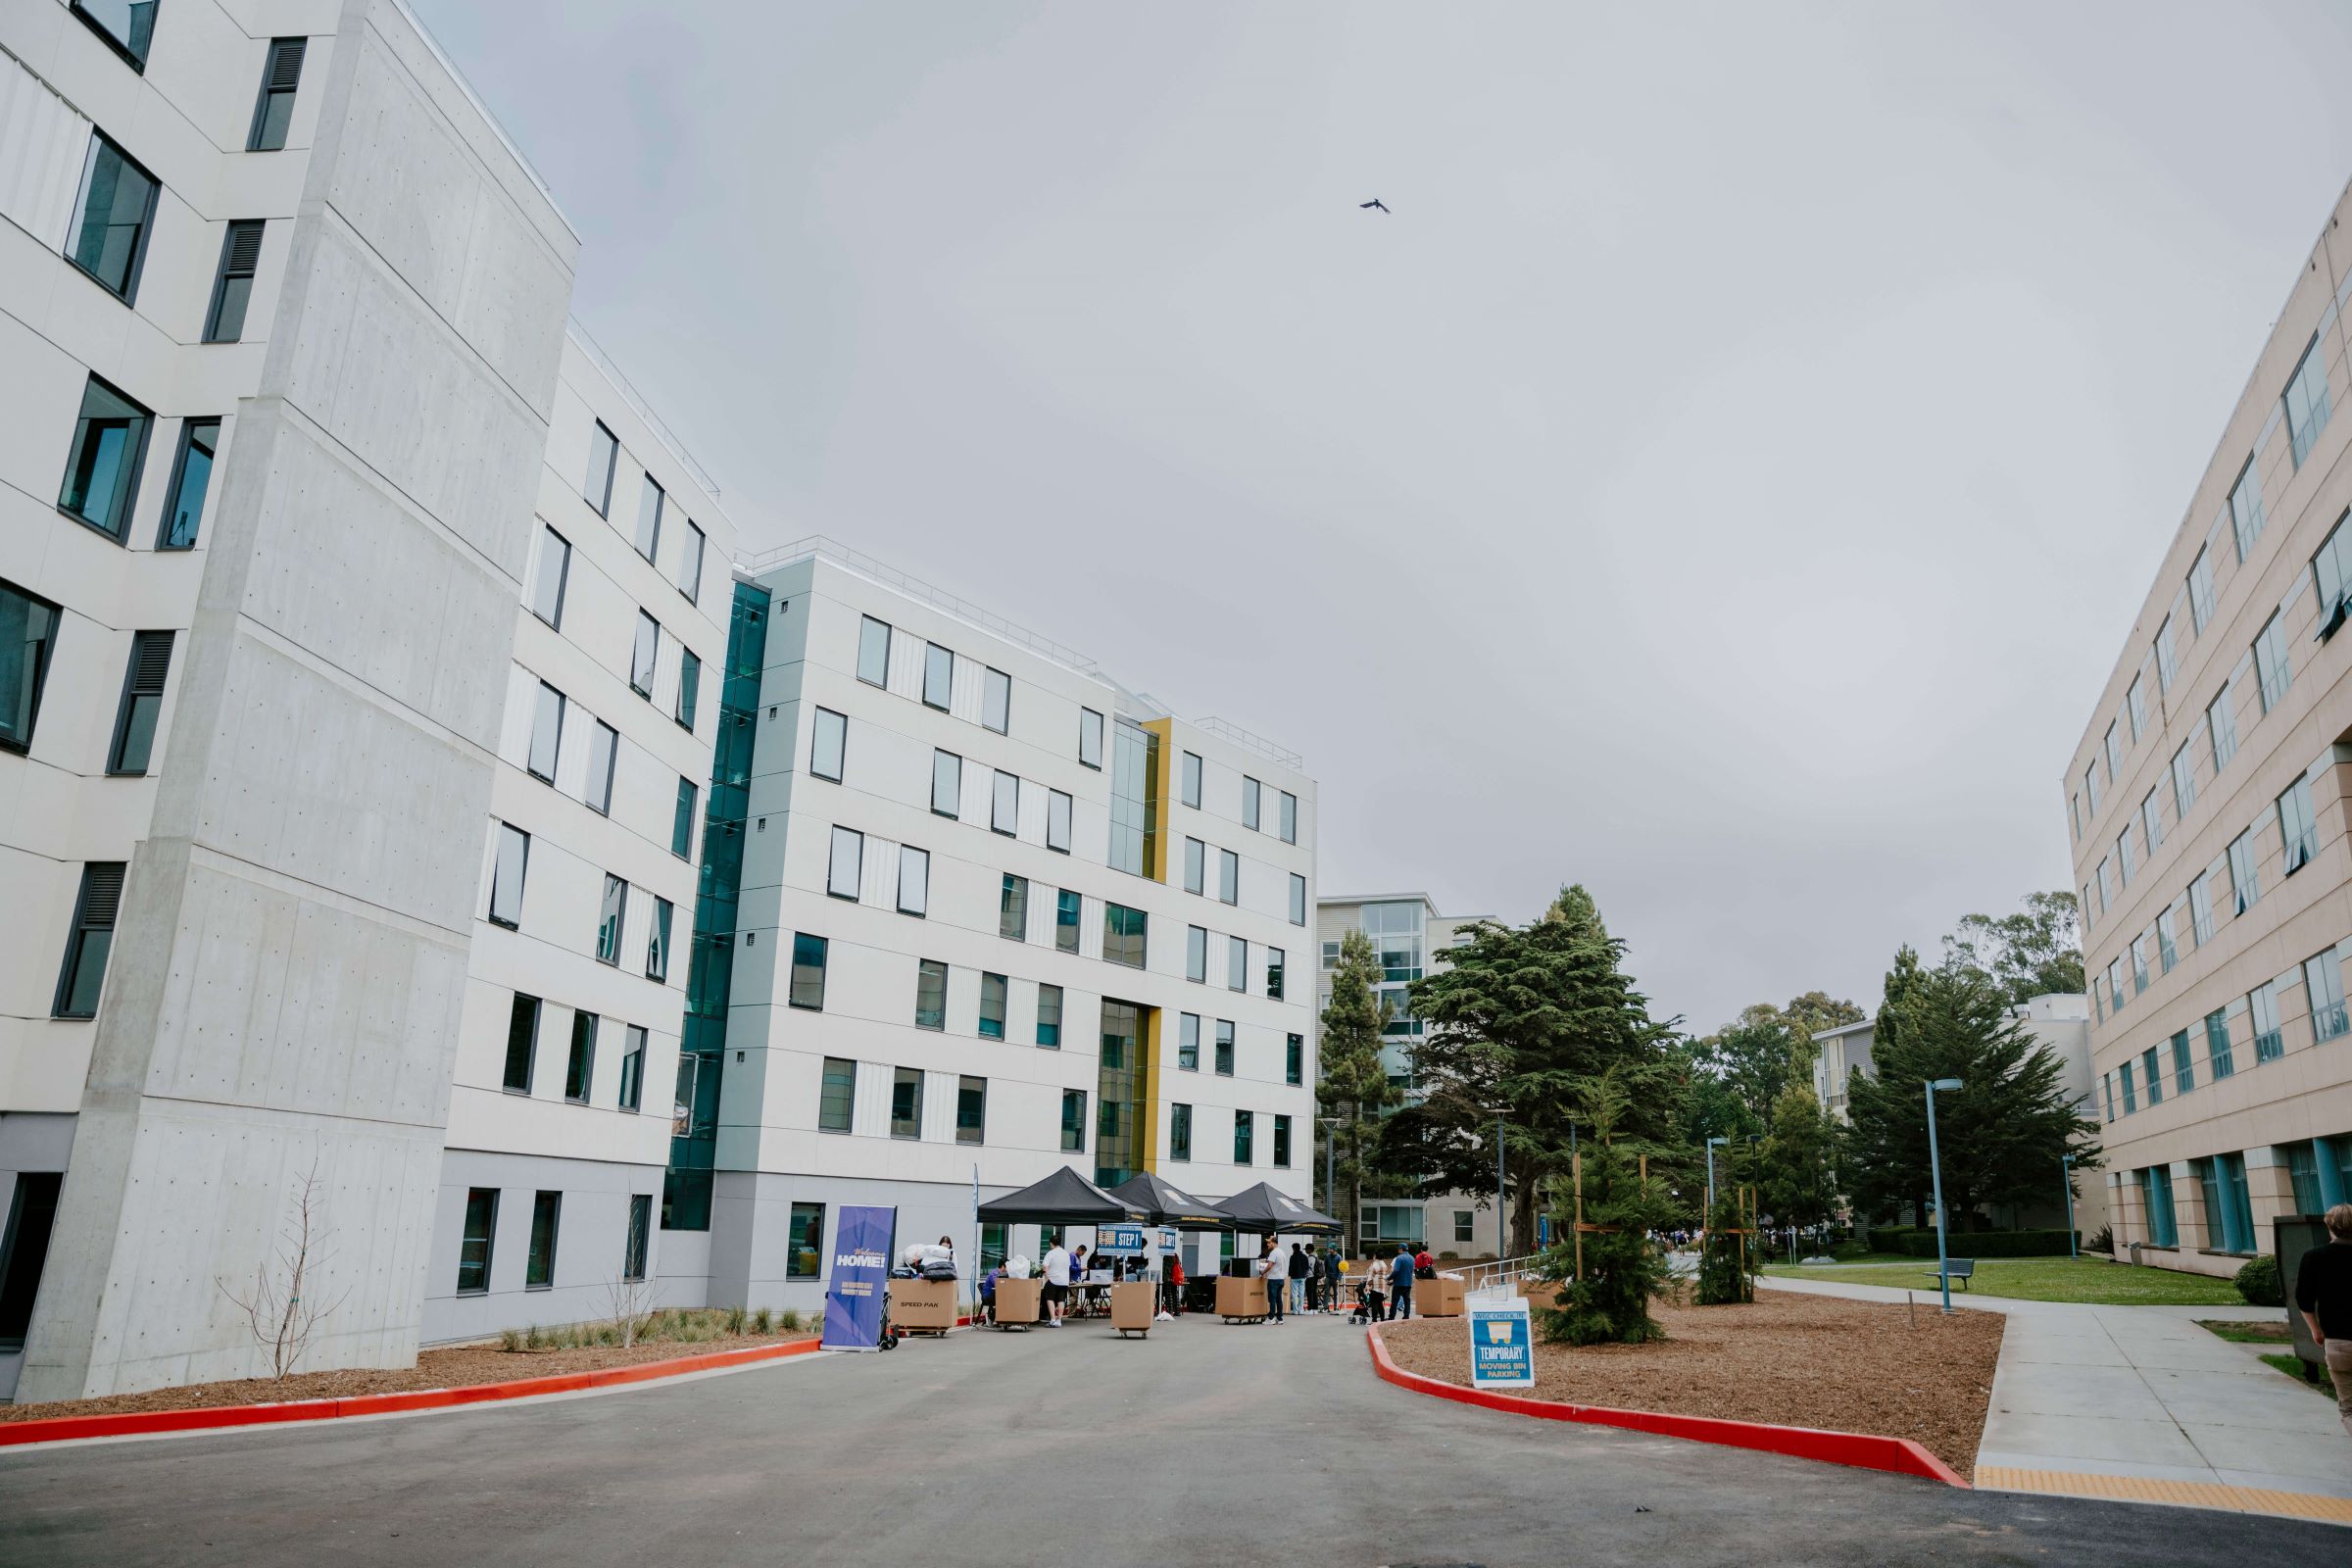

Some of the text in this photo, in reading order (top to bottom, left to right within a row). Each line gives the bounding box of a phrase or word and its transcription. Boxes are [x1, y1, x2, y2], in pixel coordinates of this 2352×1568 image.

[1118, 1233, 1139, 1247] STEP 1
[853, 1248, 886, 1257] Welcome
[836, 1254, 886, 1268] HOME!
[1480, 1347, 1523, 1360] TEMPORARY
